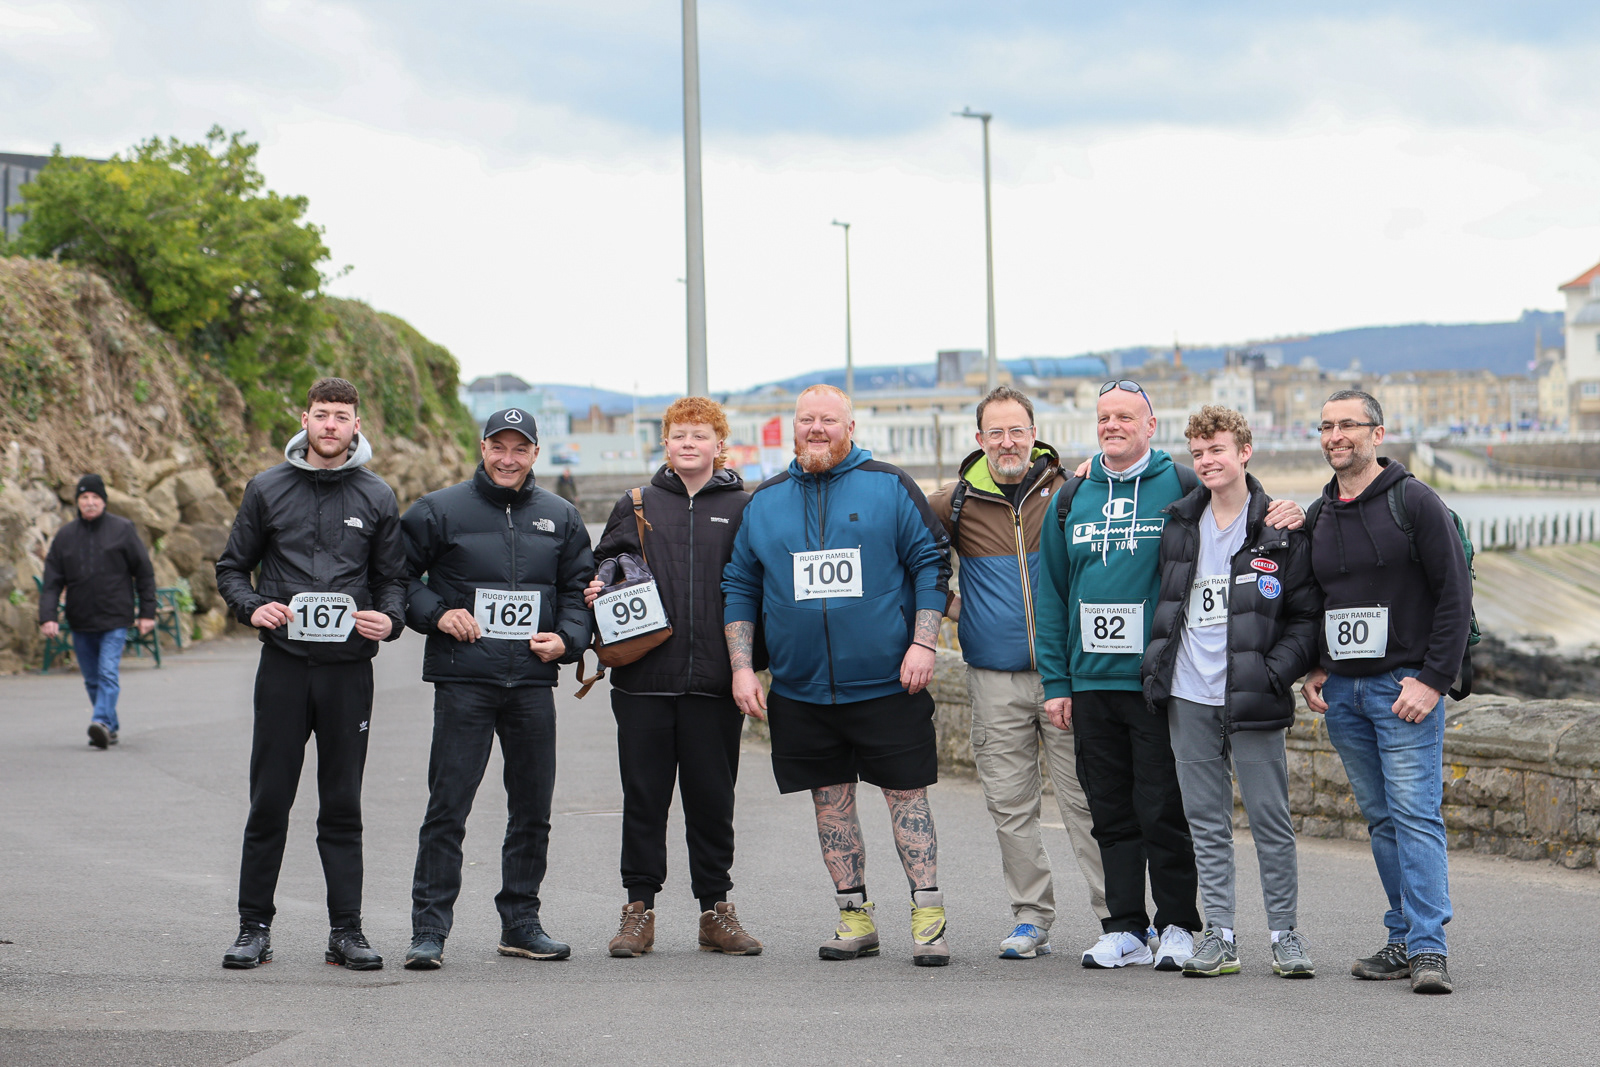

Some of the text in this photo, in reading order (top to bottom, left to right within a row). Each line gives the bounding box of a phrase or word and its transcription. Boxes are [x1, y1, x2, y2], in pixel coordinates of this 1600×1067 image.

[800, 552, 855, 562] RUGBY RAMBLE
[803, 560, 853, 585] 100
[1194, 579, 1210, 590] RUGBY
[1211, 577, 1230, 585] RAM
[482, 592, 507, 601] RUGBY
[599, 585, 651, 606] RUGBY RAMBLE
[1202, 587, 1228, 612] 81
[297, 604, 348, 628] 167
[485, 602, 532, 627] 162
[612, 597, 647, 626] 99
[1329, 612, 1349, 620] RUGBY
[1094, 615, 1125, 640] 82
[1337, 620, 1369, 646] 80
